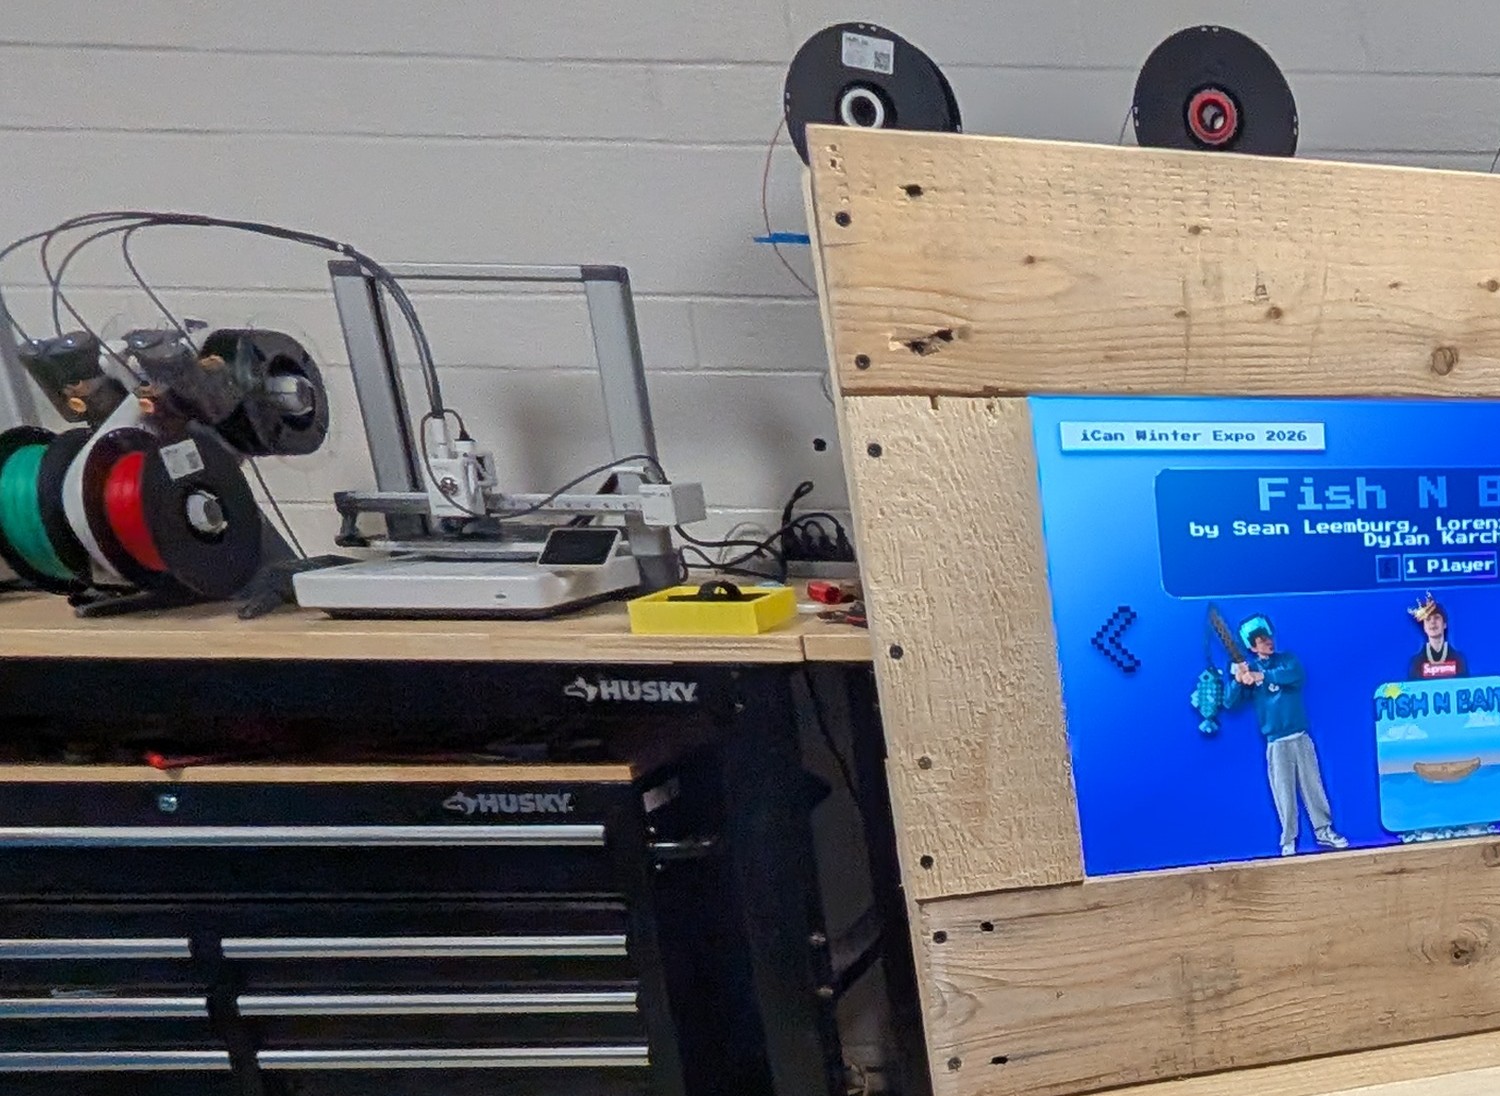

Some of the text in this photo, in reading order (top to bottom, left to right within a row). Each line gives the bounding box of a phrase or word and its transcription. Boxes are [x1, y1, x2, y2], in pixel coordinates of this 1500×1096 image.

[1081, 429, 1308, 442] iCan Winter Expo 2026
[1258, 476, 1387, 511] Fish
[1418, 475, 1447, 509] N
[1190, 521, 1219, 537] by
[1233, 520, 1290, 536] Sean
[1304, 518, 1419, 535] Leemburg,
[1364, 530, 1430, 548] Dylan
[1406, 558, 1496, 574] 1 Player
[600, 680, 697, 701] HUSKY
[1374, 693, 1429, 721] FISH
[1433, 690, 1450, 715] N
[477, 793, 572, 813] HUSKY
